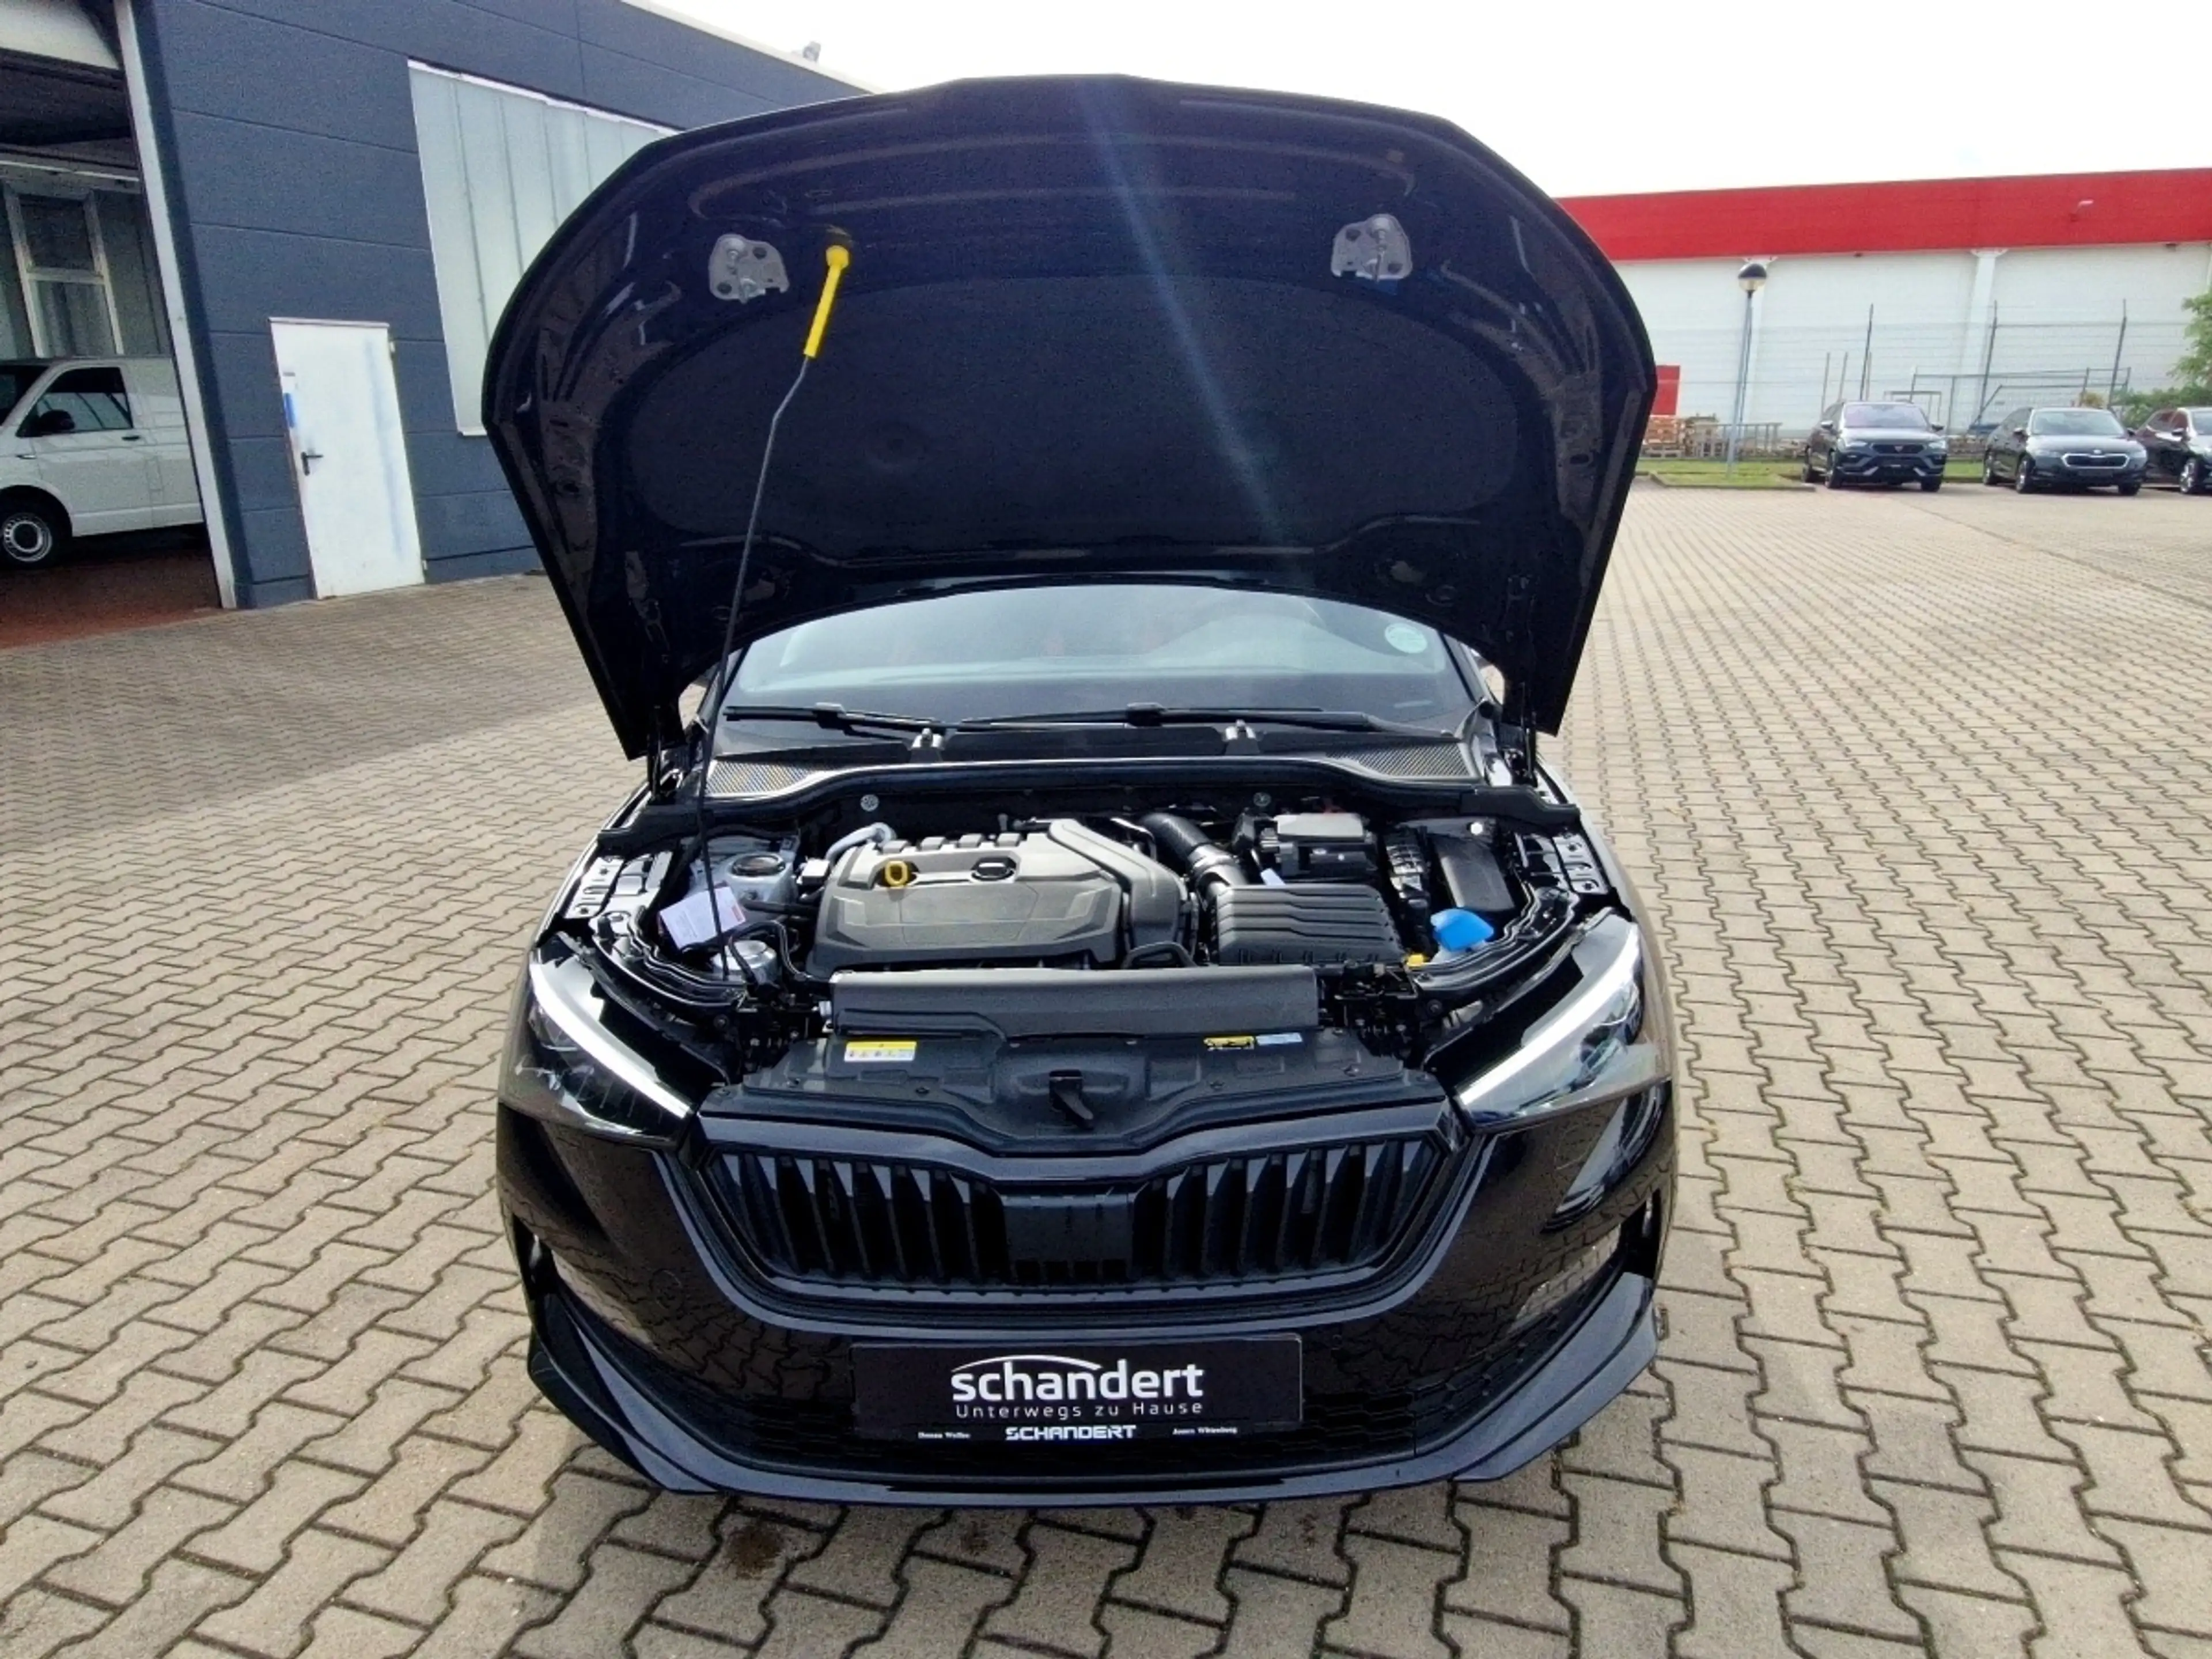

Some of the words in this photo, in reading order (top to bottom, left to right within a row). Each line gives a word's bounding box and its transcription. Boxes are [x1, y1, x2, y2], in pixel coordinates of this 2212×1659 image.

[951, 1358, 1204, 1402] schandert
[956, 1404, 1082, 1421] Unterwegs
[1095, 1405, 1119, 1417] zu
[1132, 1402, 1204, 1415] Hause
[1005, 1425, 1137, 1441] SCHANDERT
